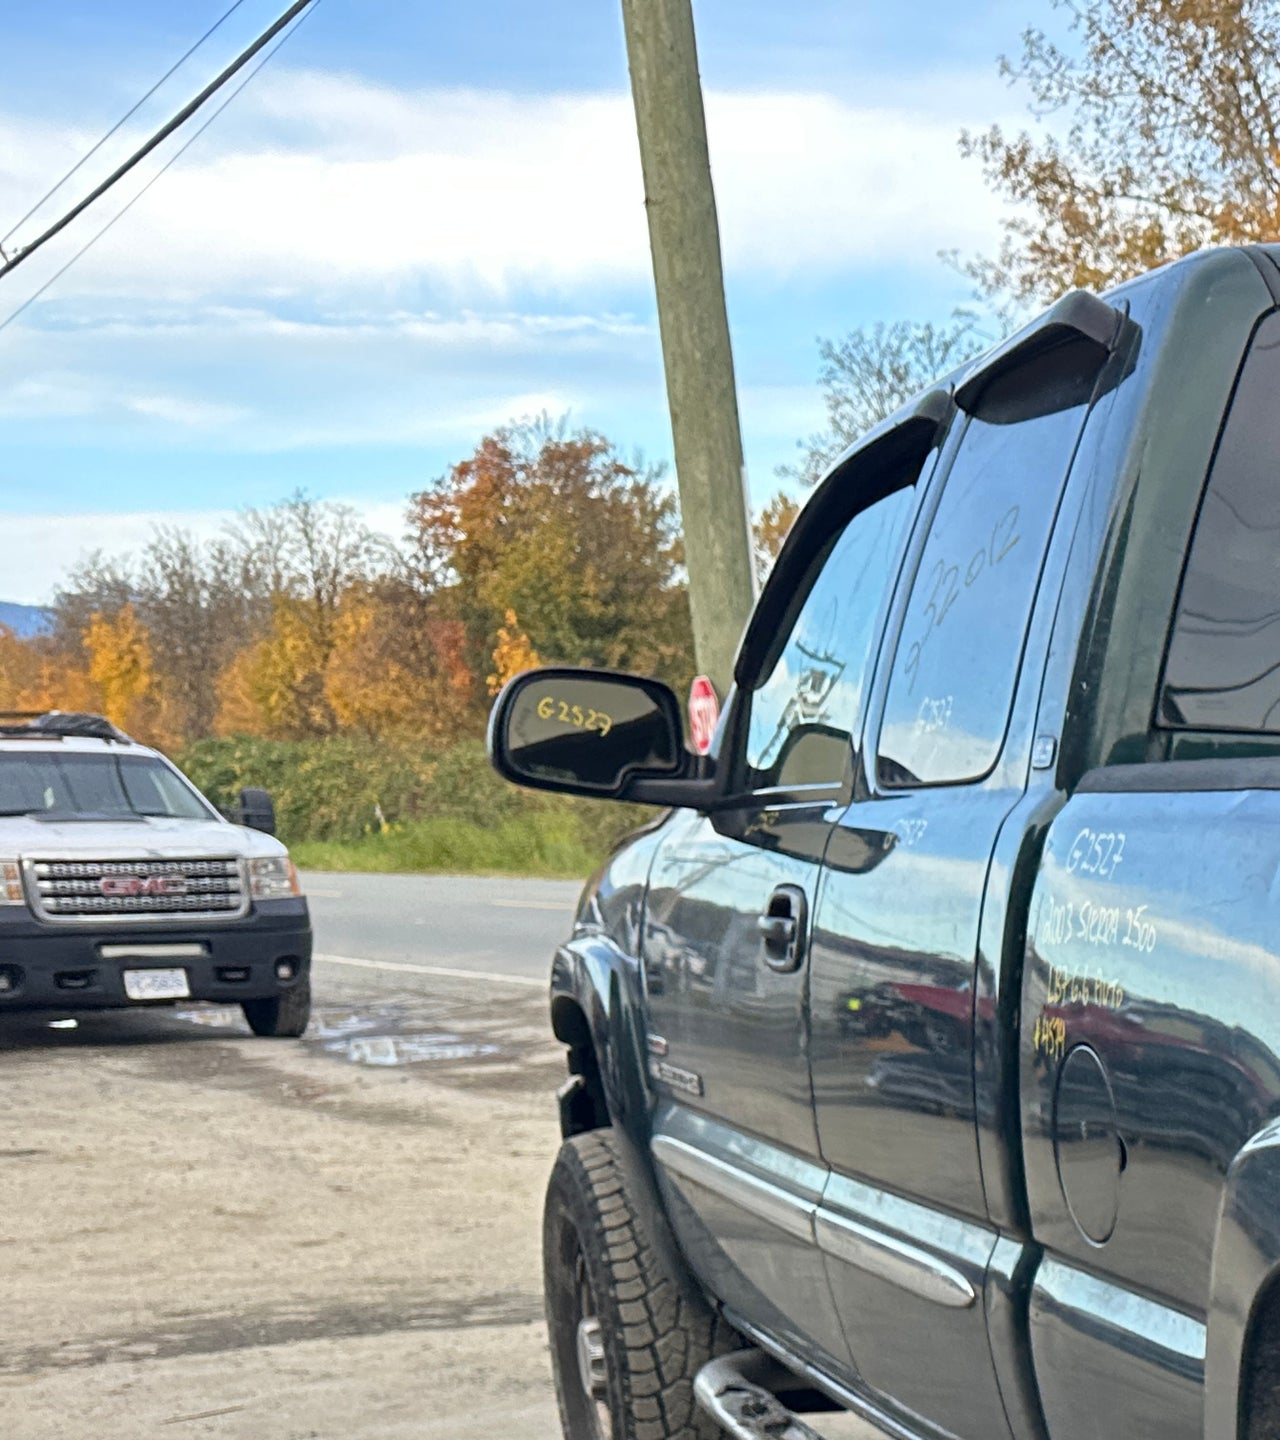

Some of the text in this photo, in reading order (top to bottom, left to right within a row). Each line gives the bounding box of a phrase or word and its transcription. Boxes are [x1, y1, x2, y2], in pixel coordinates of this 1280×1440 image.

[536, 697, 613, 738] G2527
[1066, 827, 1126, 881] G2527
[101, 876, 187, 896] GMC
[1041, 895, 1074, 945] 2003
[1121, 904, 1157, 953] 2500
